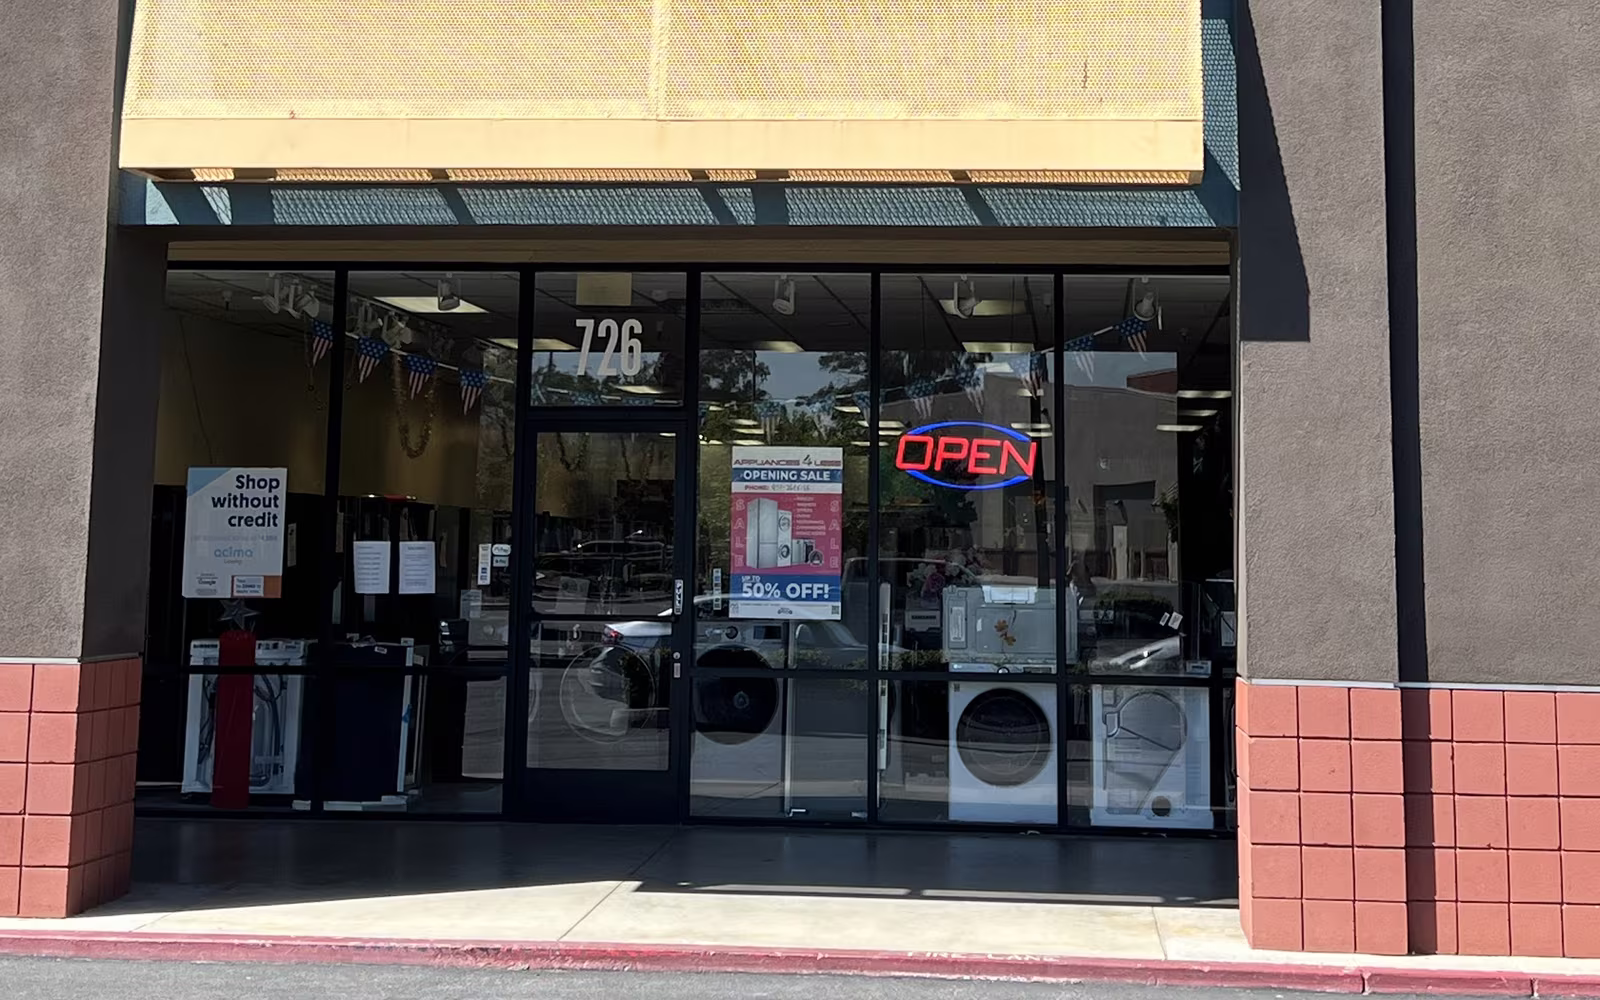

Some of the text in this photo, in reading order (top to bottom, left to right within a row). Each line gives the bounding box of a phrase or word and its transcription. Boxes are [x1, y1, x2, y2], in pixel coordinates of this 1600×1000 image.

[576, 318, 643, 376] 726
[895, 433, 1038, 477] OPEN
[235, 474, 280, 493] Shop
[743, 470, 831, 481] OPENING SALE
[211, 492, 279, 508] without
[228, 511, 278, 527] credit
[742, 582, 829, 599] 50% OFF!
